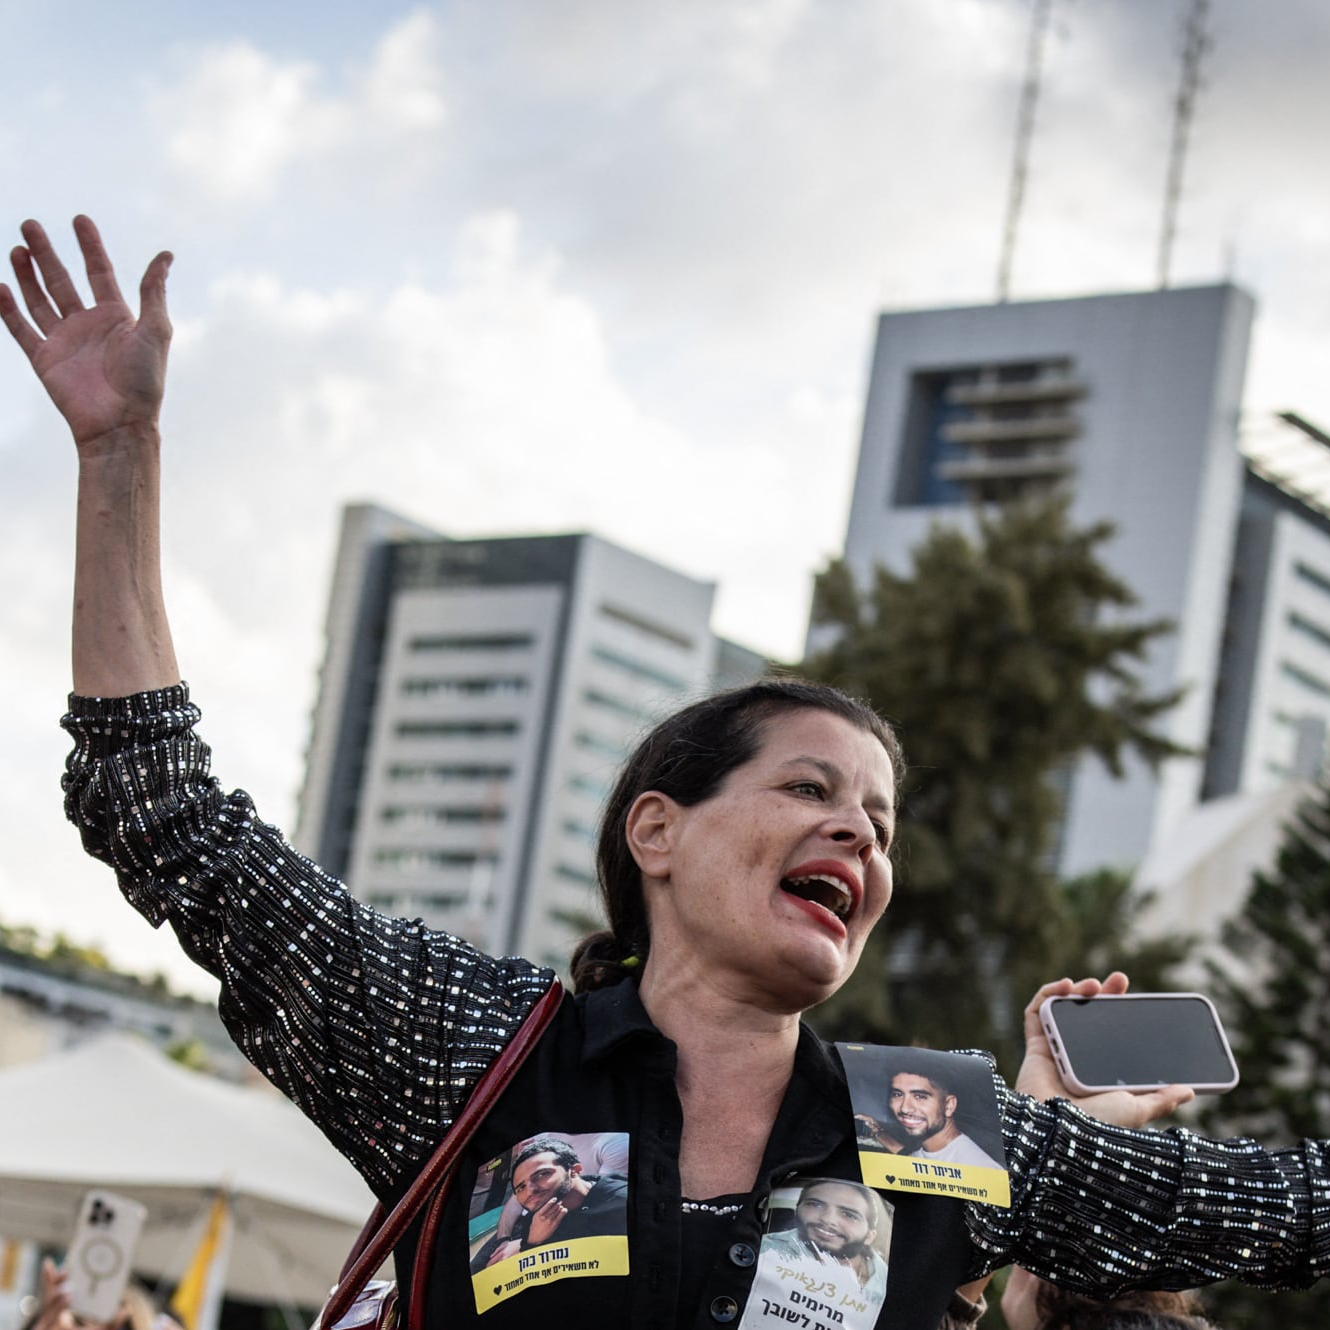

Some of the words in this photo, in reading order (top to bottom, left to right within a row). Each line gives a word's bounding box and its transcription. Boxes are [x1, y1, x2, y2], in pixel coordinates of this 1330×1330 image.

[912, 1162, 929, 1174] דוד
[931, 1165, 962, 1179] אביתר
[898, 1178, 921, 1188] מאחור
[949, 1184, 978, 1197] משאירים
[979, 1188, 988, 1198] לא
[539, 1247, 569, 1264] נמרוד
[518, 1254, 536, 1272] כהן
[553, 1261, 587, 1274] משאירים
[589, 1260, 599, 1270] לא
[525, 1270, 540, 1282] אחד
[542, 1267, 552, 1278] אף
[504, 1276, 524, 1292] מאחור
[762, 1298, 811, 1329] לשובך
[789, 1290, 844, 1324] מרימים
